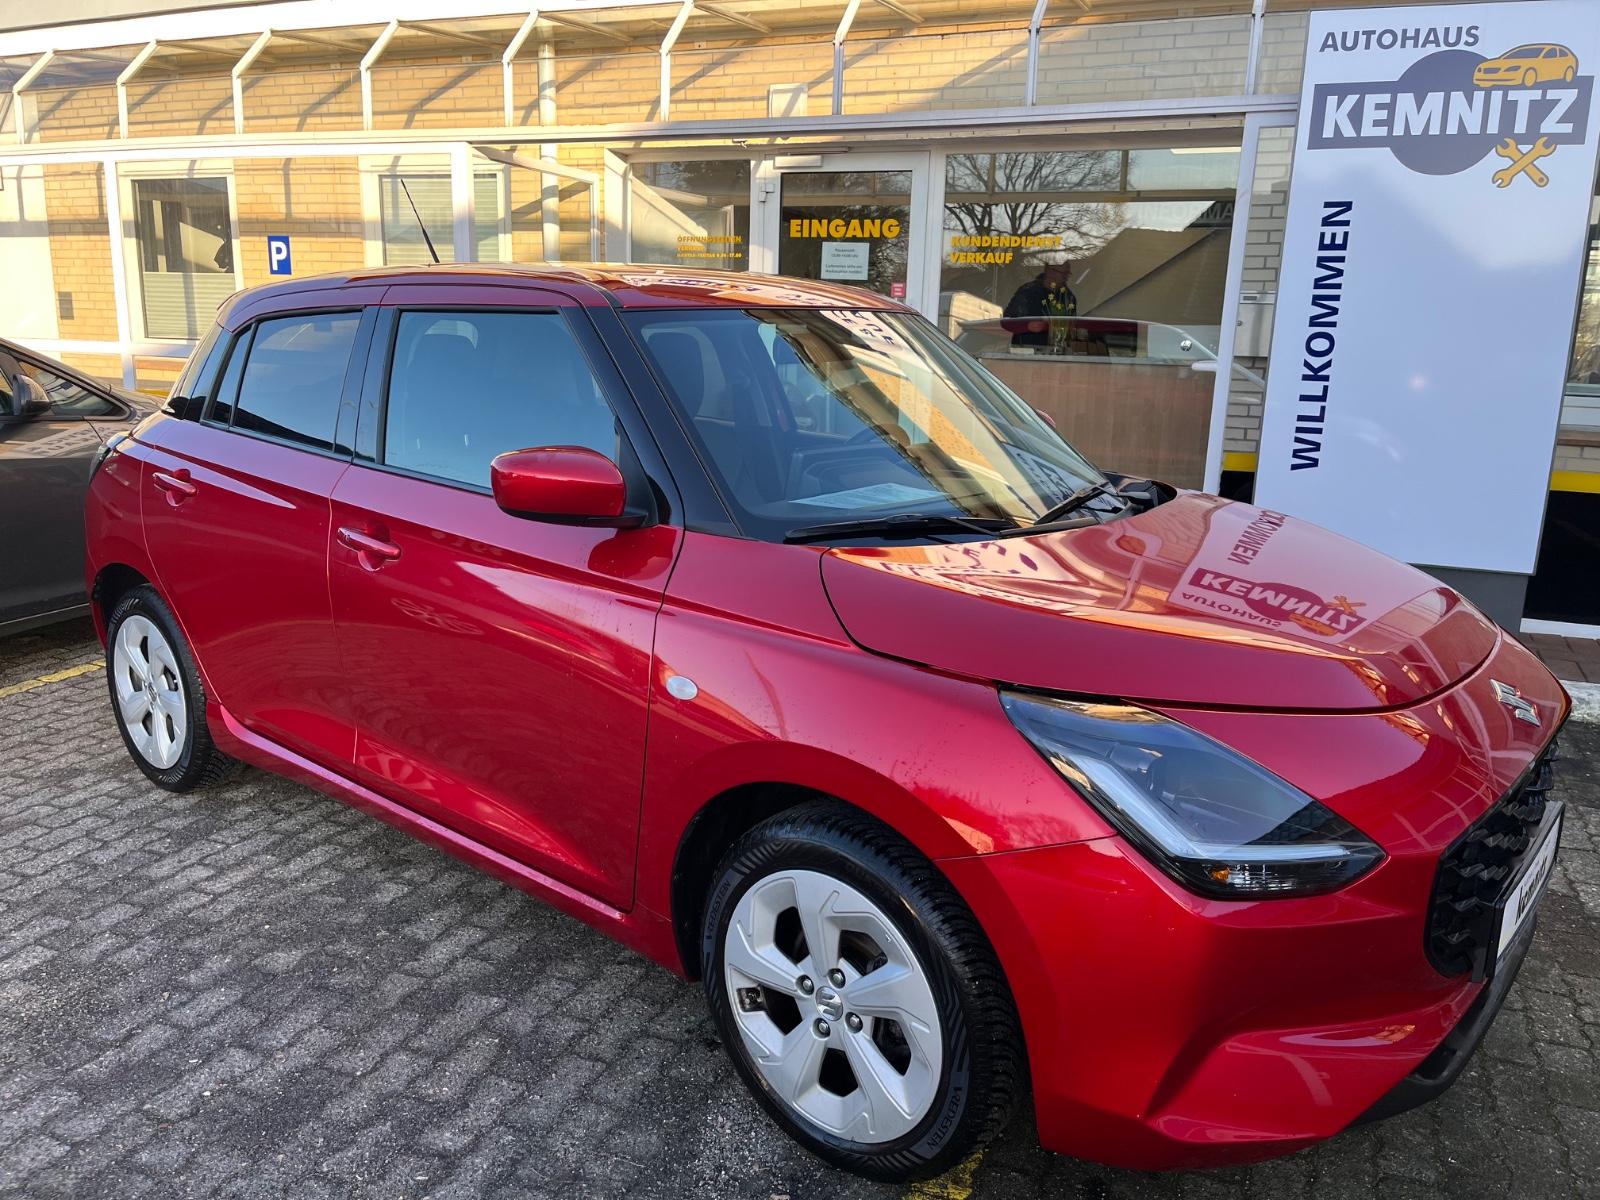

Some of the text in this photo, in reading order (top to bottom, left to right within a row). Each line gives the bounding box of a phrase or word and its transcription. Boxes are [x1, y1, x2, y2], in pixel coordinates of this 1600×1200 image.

[1319, 25, 1480, 52] AUTOHAUS
[1321, 88, 1578, 138] KEMNITZ
[789, 218, 900, 239] EINGANG
[951, 235, 1063, 248] KUNDENDIENST
[271, 241, 287, 270] P
[951, 252, 1013, 264] VERKAUF
[1290, 200, 1353, 471] WILLKOMMEN
